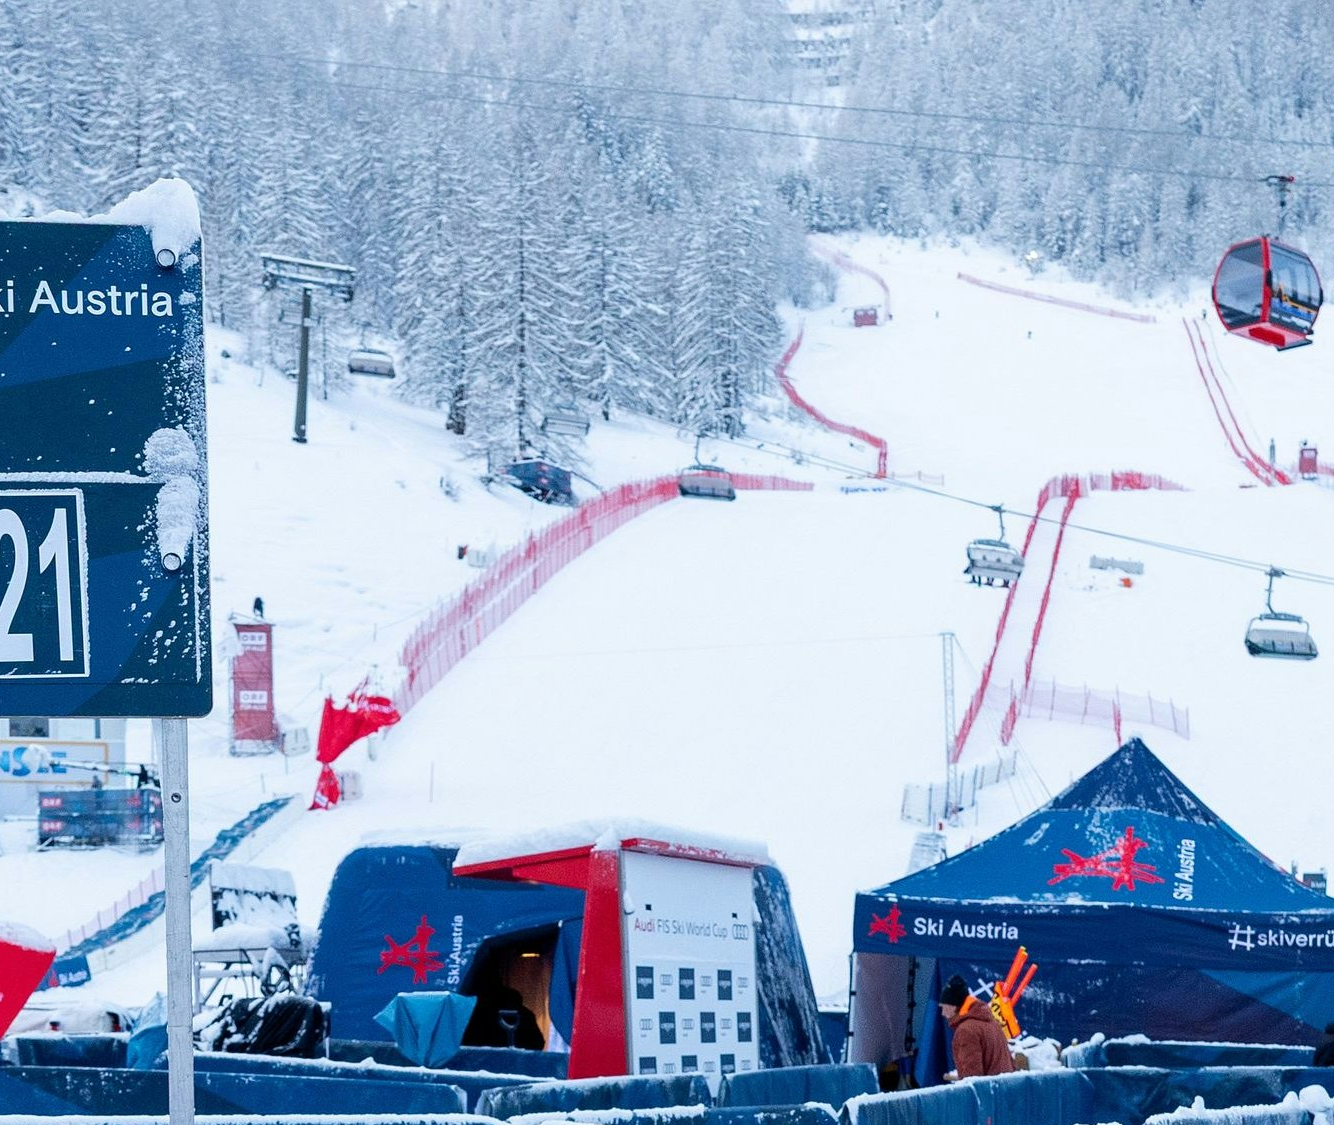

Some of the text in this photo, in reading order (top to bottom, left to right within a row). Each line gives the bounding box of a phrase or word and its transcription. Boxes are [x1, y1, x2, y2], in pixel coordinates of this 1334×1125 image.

[29, 280, 173, 318] Austria
[1172, 839, 1196, 902] Ski Austria
[634, 918, 728, 940] Audi FIS Ski World Cup
[913, 916, 1019, 940] Ski Austria
[447, 915, 464, 985] Ski Austria
